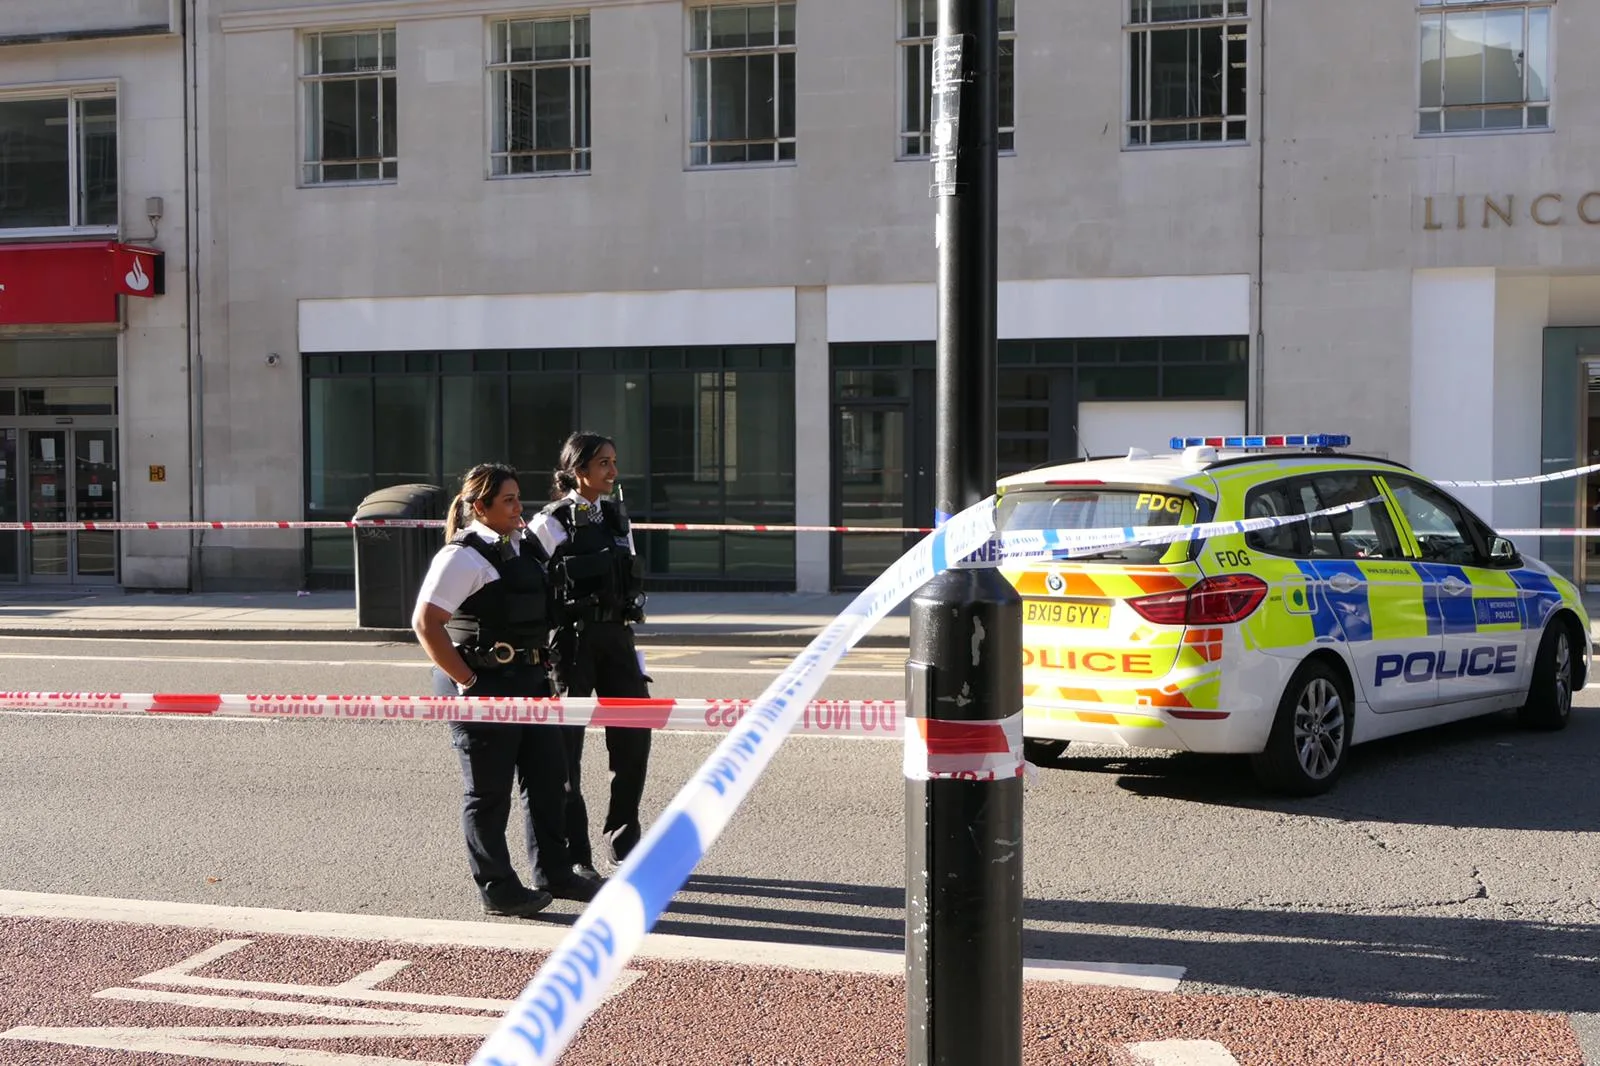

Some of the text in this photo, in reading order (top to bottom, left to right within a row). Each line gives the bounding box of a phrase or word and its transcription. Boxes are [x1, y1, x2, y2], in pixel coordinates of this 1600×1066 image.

[1135, 494, 1183, 513] FDG
[1215, 550, 1251, 568] FDG
[1028, 604, 1100, 624] BX19 GYY
[1374, 643, 1518, 687] POLICE
